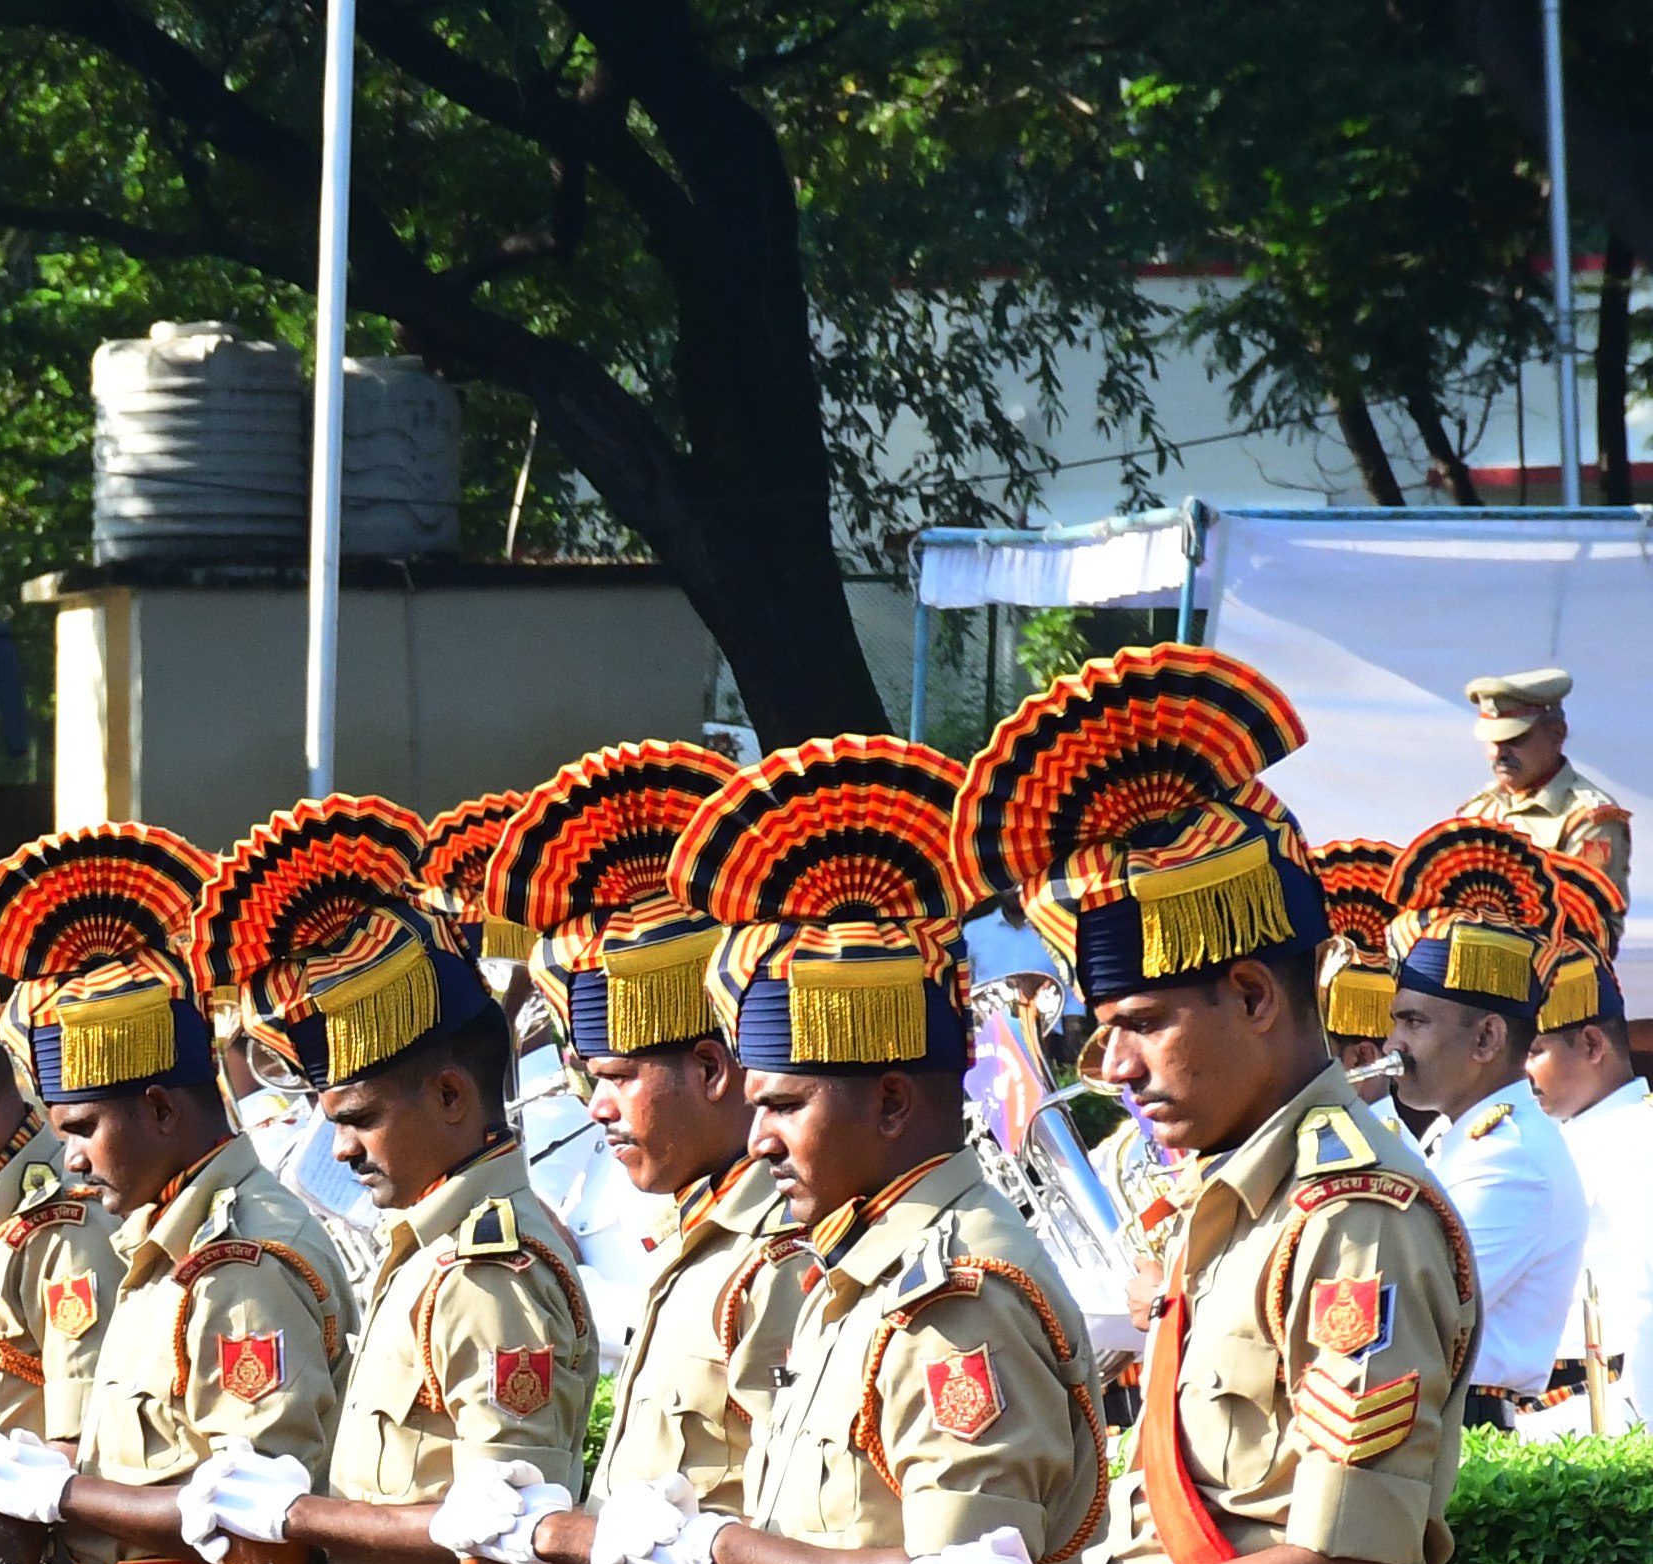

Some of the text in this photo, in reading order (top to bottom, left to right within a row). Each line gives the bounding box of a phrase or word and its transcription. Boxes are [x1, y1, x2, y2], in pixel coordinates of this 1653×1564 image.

[1301, 1174, 1408, 1205] मध्य प्रदेश पुलिस
